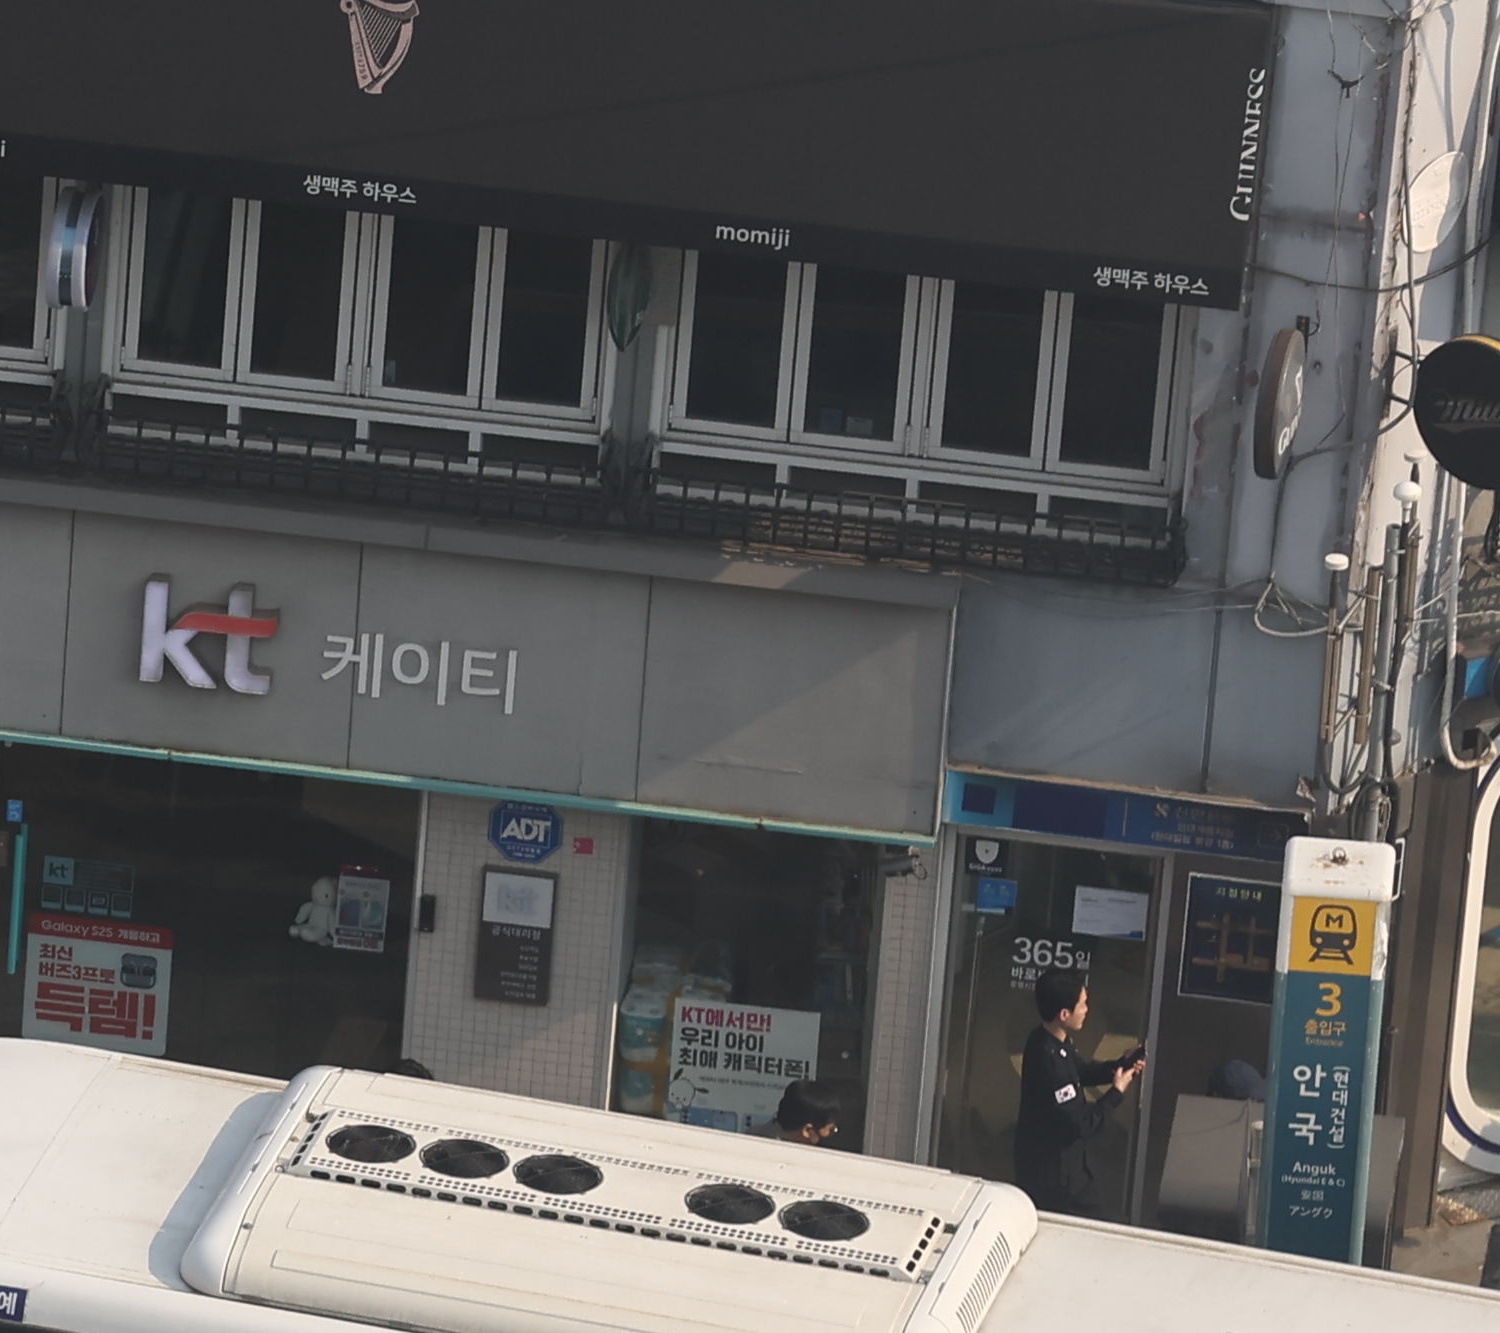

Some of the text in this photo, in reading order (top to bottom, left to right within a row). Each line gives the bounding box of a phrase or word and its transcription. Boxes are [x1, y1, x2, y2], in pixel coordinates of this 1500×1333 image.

[1230, 67, 1266, 221] GUINNESS
[303, 174, 417, 205] 생맥주 하우스
[715, 225, 790, 251] momiji
[1093, 266, 1209, 296] 생맥주 하우스
[139, 574, 279, 696] kt
[321, 633, 518, 715] 케이티
[500, 817, 551, 843] ADT
[41, 918, 90, 936] Galaxy
[91, 923, 114, 938] S25
[40, 943, 74, 962] 최신
[1012, 936, 1092, 971] 365일
[39, 962, 116, 985] 버즈3프로
[34, 981, 157, 1041] 득템!
[1315, 983, 1342, 1017] 3
[681, 1006, 772, 1033] KT에서만!
[1304, 1019, 1346, 1037] 출입구
[680, 1027, 764, 1054] 우리 아이
[679, 1046, 809, 1081] 최애 캐릭터폰!
[1288, 1064, 1327, 1146] 안국
[1328, 1065, 1352, 1150] (현대건설)
[1293, 1162, 1336, 1177] Anguk
[1289, 1205, 1334, 1220] アングク
